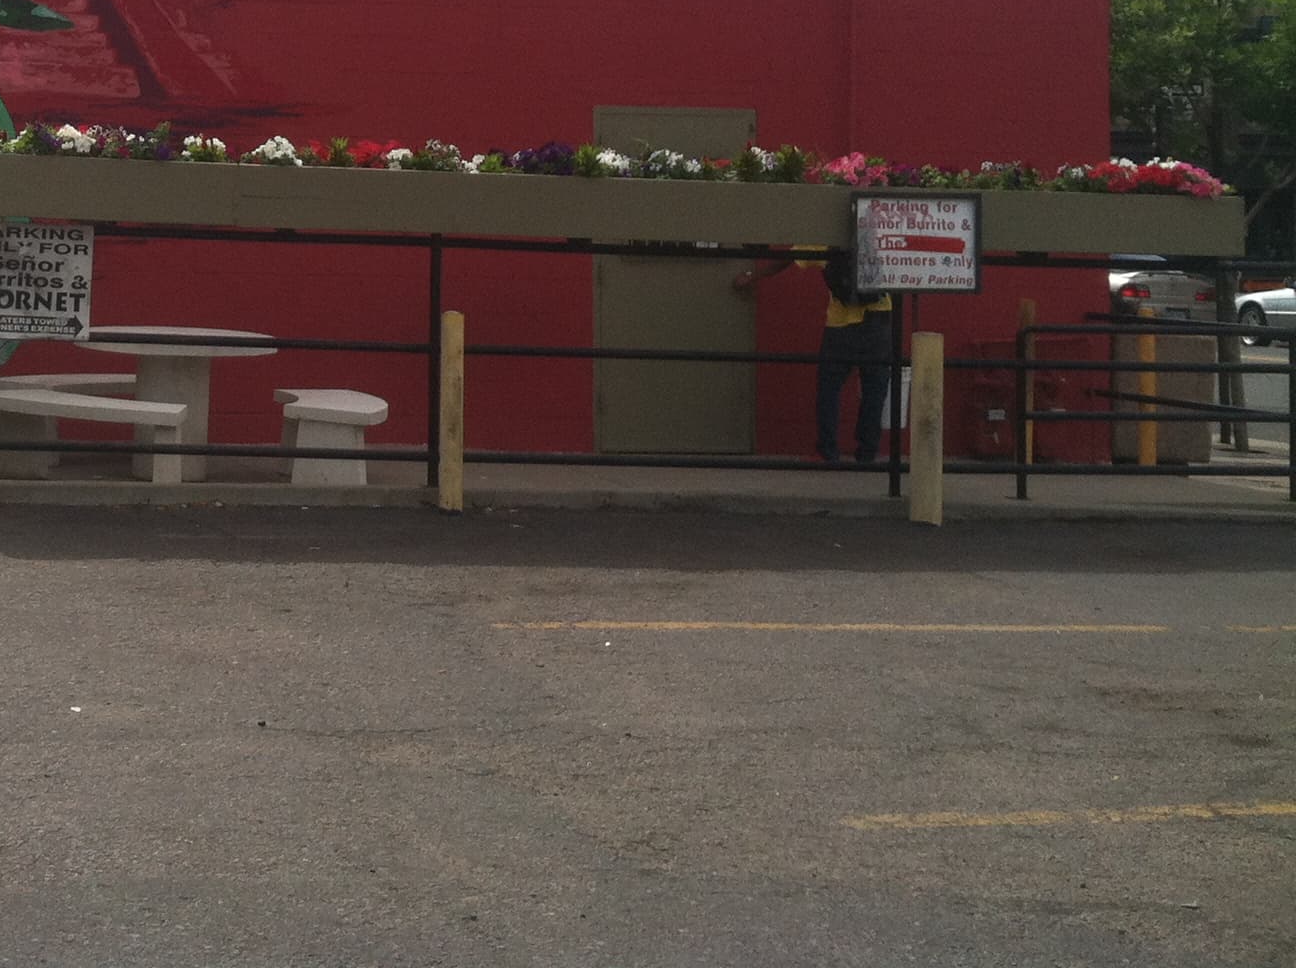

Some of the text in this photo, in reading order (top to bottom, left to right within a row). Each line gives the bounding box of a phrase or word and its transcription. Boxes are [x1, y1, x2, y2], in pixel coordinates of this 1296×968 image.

[869, 200, 958, 216] Parking for
[907, 218, 955, 231] Burrito
[961, 219, 972, 230] &
[39, 243, 88, 255] FOR
[877, 237, 902, 249] The
[71, 275, 88, 290] &
[901, 274, 922, 286] Day
[928, 274, 973, 286] Parking
